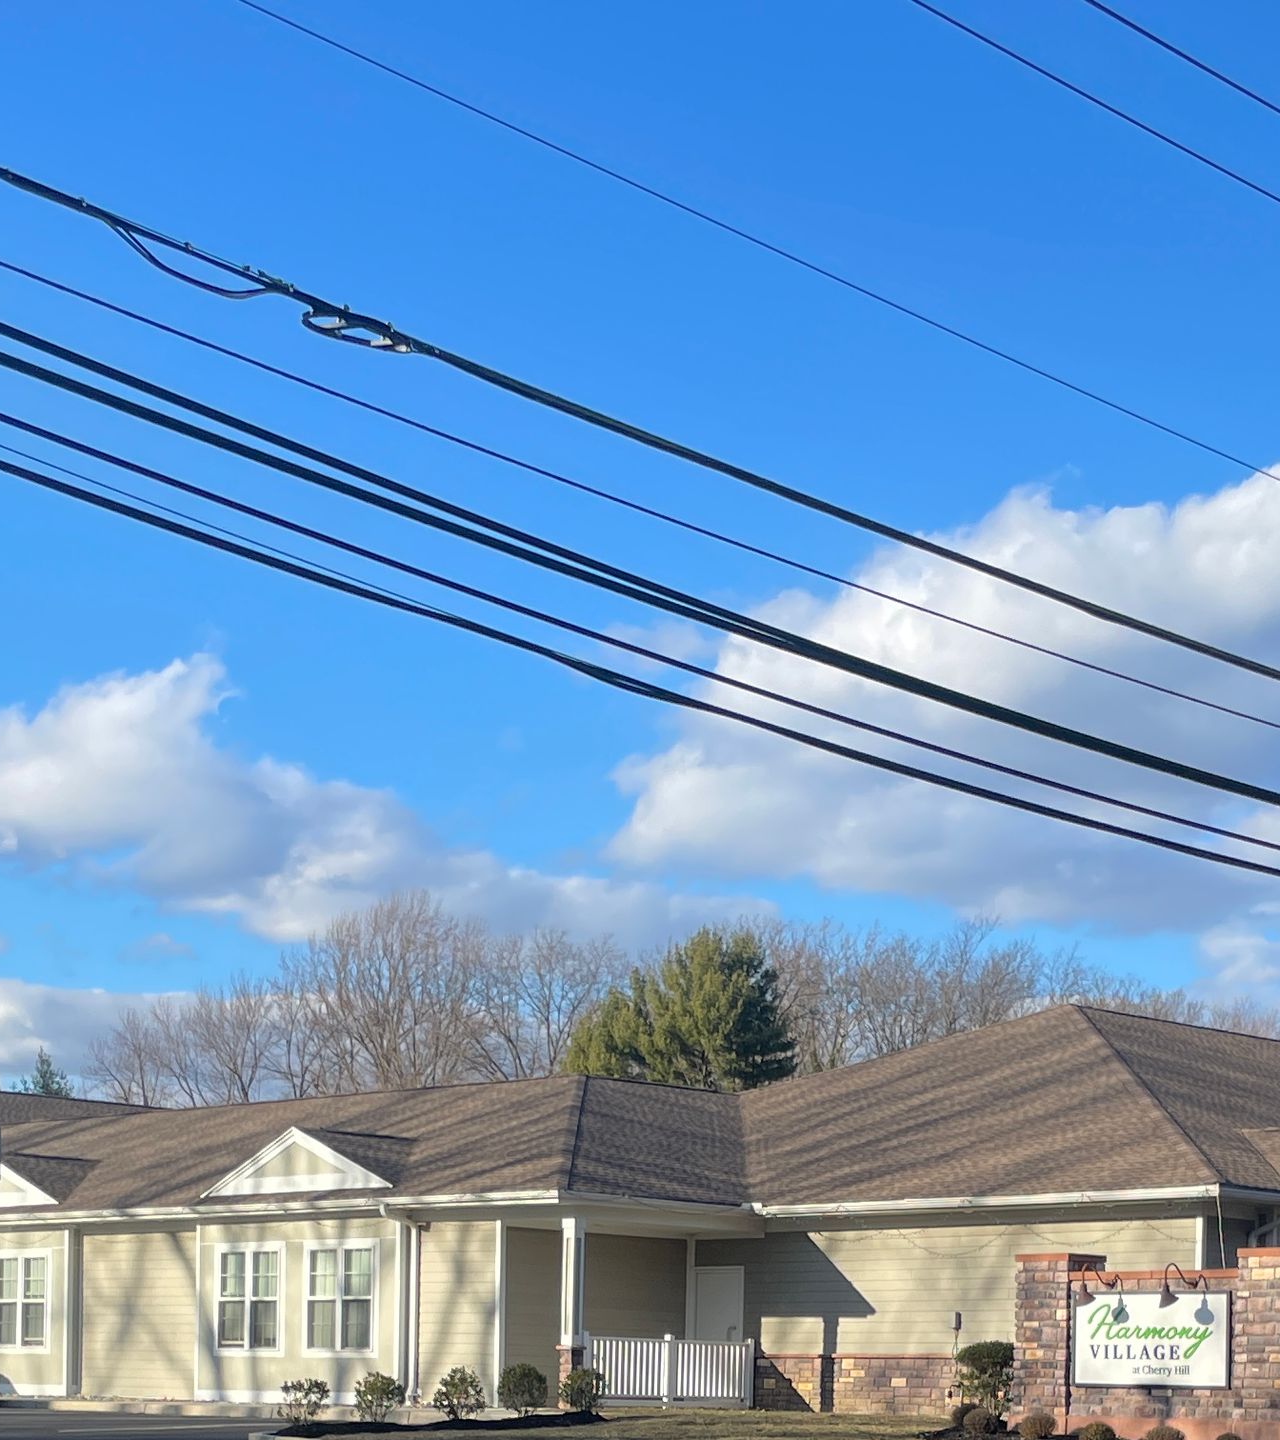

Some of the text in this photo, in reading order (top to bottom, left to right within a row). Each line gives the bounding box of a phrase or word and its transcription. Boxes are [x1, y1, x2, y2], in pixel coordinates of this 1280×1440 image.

[1088, 1304, 1213, 1359] Harmony
[1090, 1344, 1180, 1360] VILLAGE
[1132, 1365, 1190, 1377] at Cherry Hill
